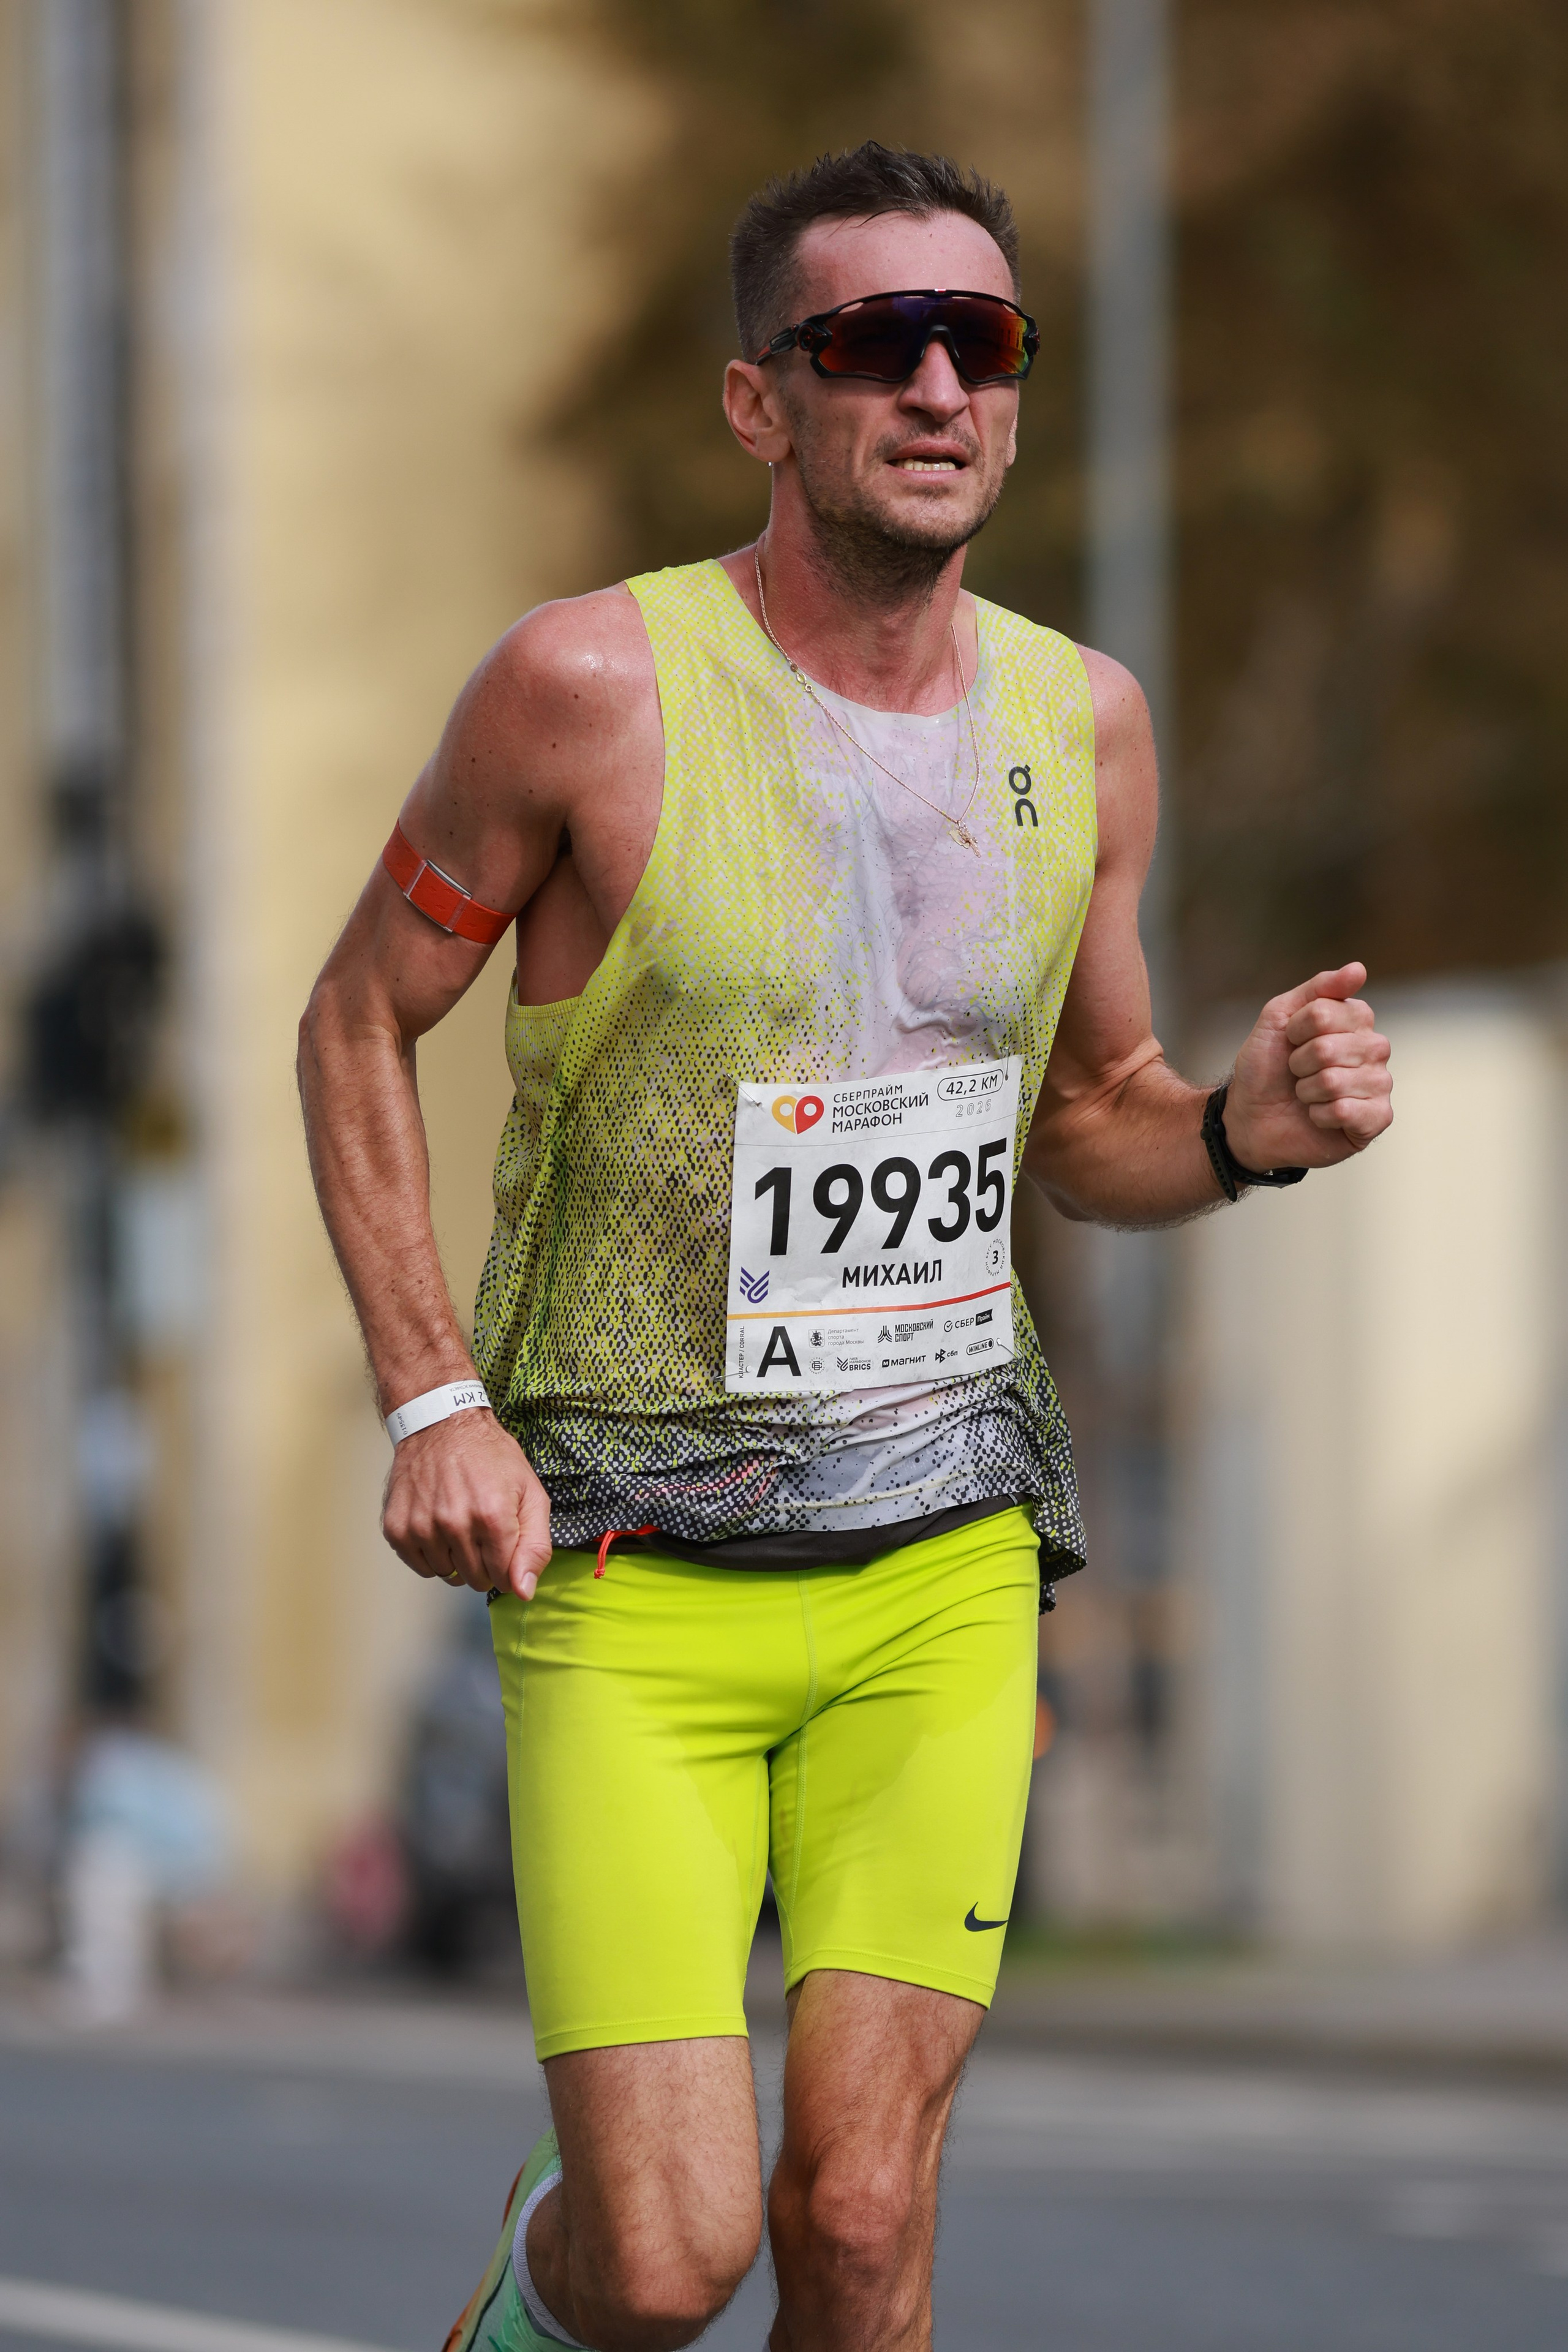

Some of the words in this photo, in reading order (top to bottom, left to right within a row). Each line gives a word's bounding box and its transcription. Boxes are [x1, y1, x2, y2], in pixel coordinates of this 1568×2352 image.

[833, 1084, 903, 1103] СБЕРПРАЙМ
[946, 1079, 976, 1095] 42,2
[832, 1092, 929, 1118] МОСКОВСКИЙ
[956, 1099, 992, 1117] 2026
[832, 1112, 902, 1133] МАРАФОН
[755, 1137, 1007, 1256] 19935
[992, 1250, 998, 1265] 3
[842, 1259, 942, 1288] МИХАИЛ
[895, 1319, 933, 1333] МОСКОВСКИЙ
[955, 1317, 974, 1329] СБЕР
[895, 1332, 914, 1342] СПОРТ
[968, 1341, 988, 1353] WINLINE
[396, 1412, 408, 1435] 013549
